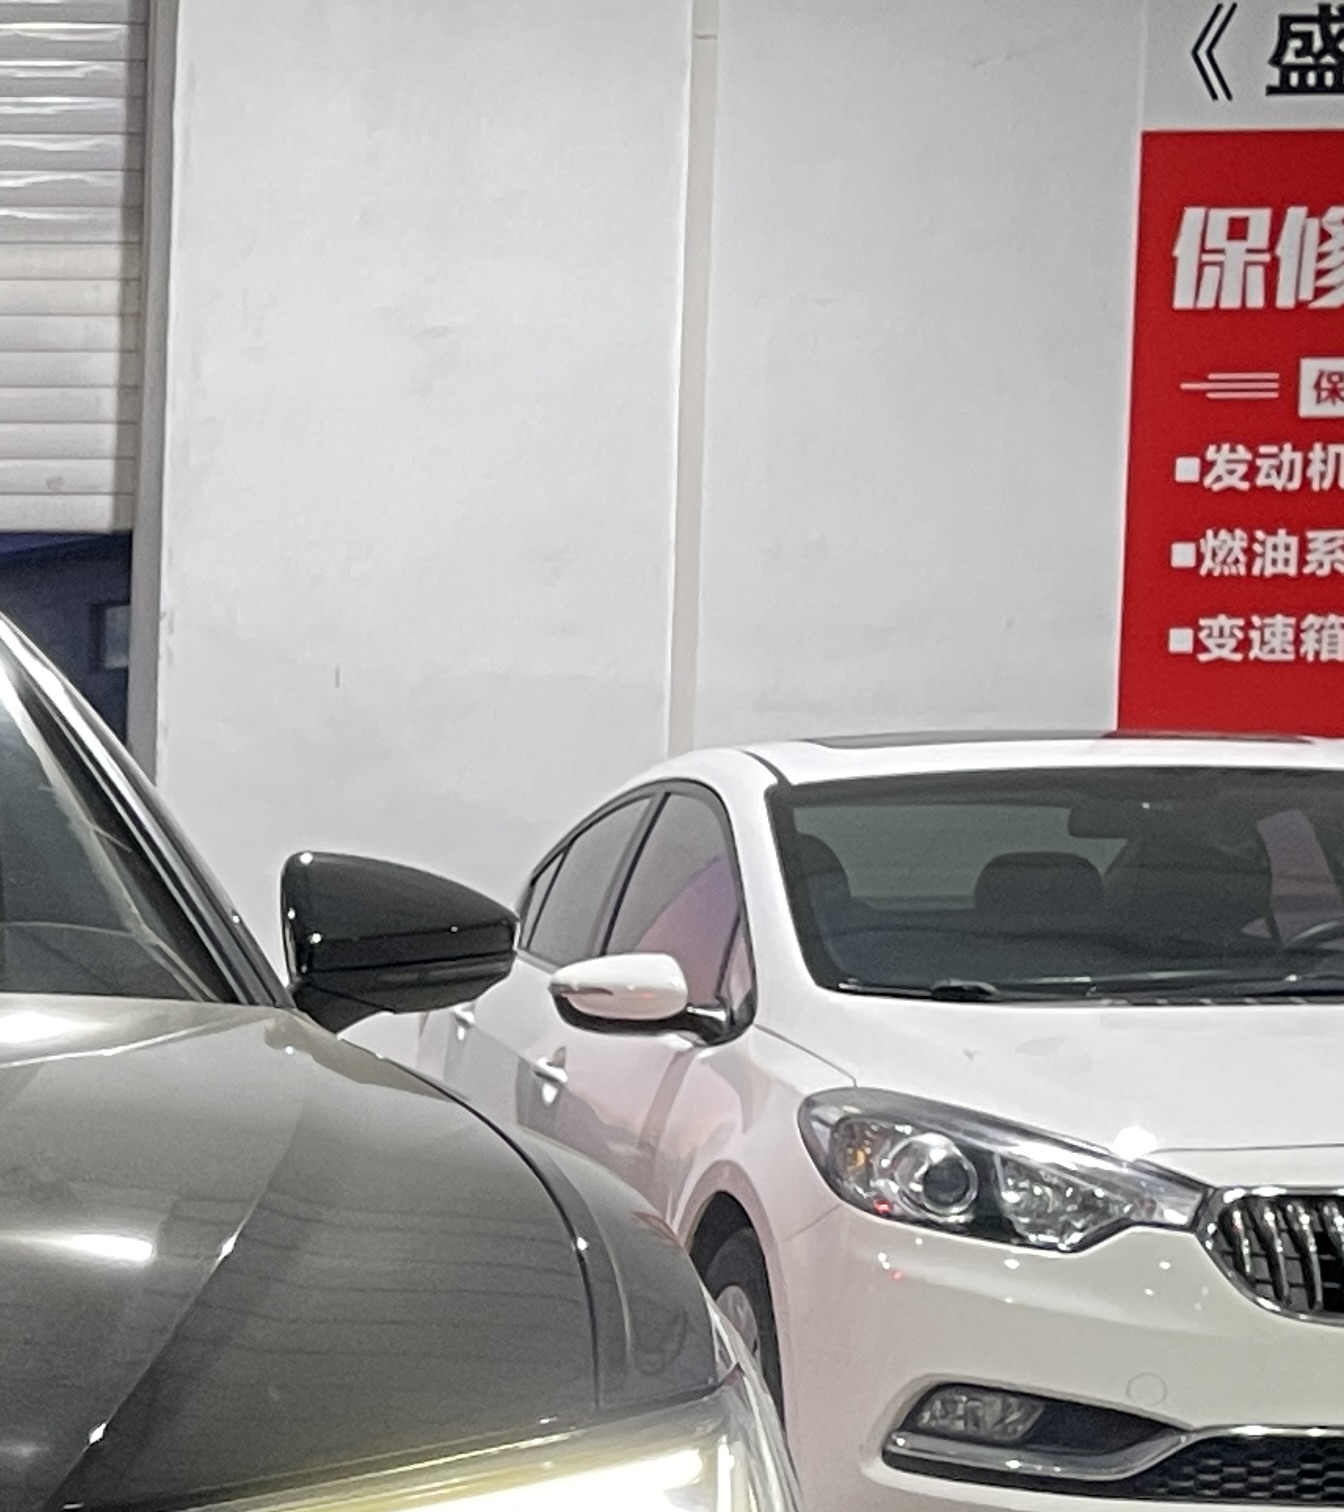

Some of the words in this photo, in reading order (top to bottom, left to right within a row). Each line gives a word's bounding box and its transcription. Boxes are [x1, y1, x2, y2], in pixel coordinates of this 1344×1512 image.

[1172, 206, 1344, 310] 保修
[1203, 442, 1344, 492] 发动机
[1198, 528, 1344, 577] 燃油系
[1196, 613, 1344, 663] 变速箱
